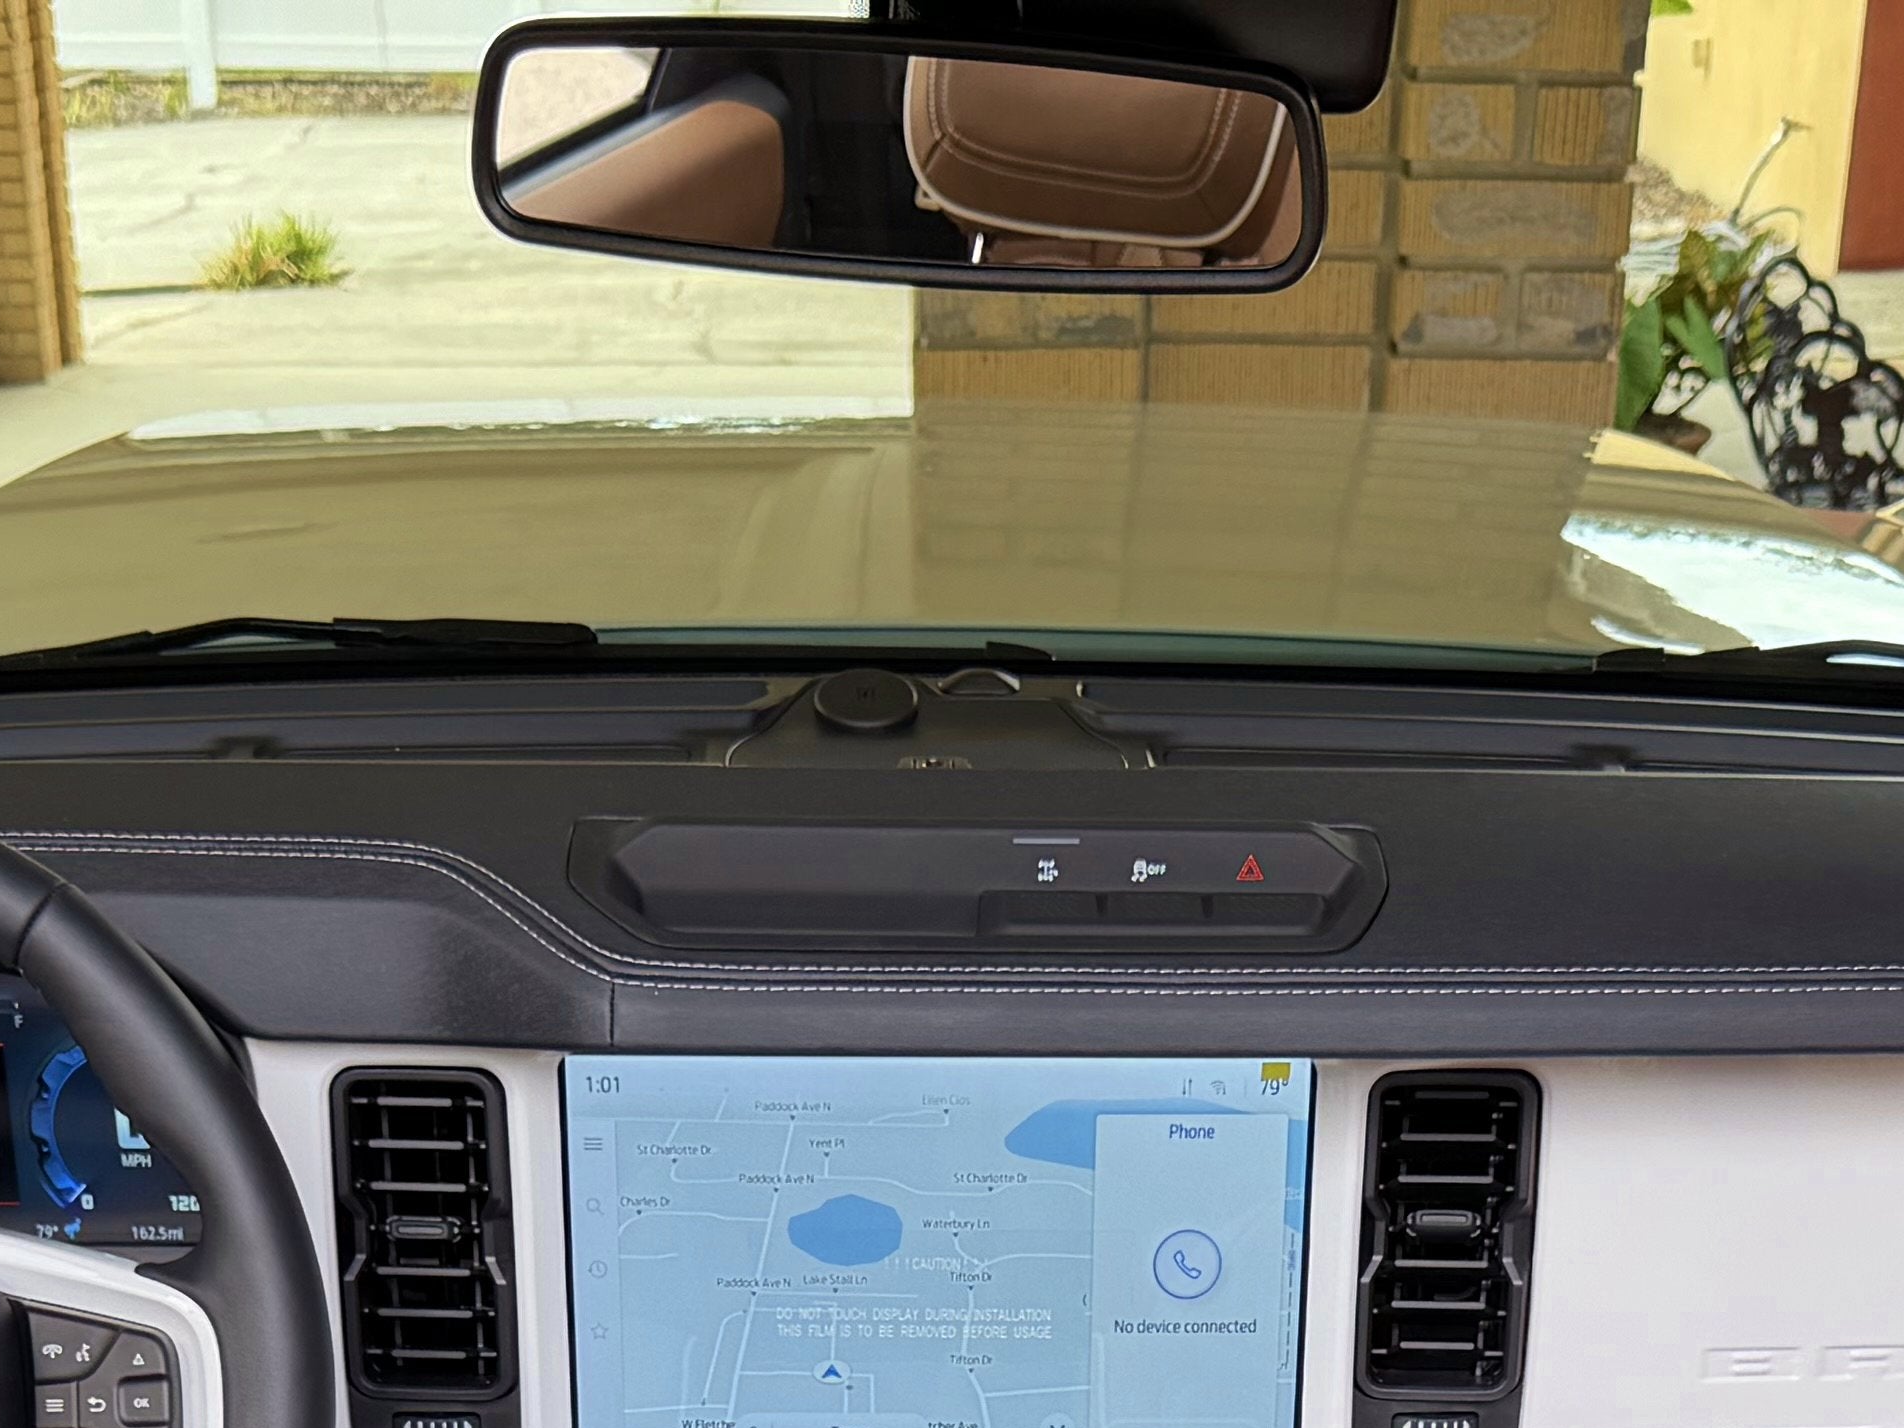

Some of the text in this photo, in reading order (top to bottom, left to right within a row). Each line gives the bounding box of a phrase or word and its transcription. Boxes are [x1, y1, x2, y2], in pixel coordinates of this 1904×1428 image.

[13, 1015, 24, 1029] F
[585, 1076, 621, 1094] 1:01
[755, 1101, 832, 1112] Paddock Ave N
[1169, 1123, 1216, 1139] Phone
[650, 1144, 698, 1155] Charlotte
[700, 1145, 712, 1155] Dr
[120, 1154, 153, 1168] MPH
[739, 1174, 815, 1185] Paddock Ave N
[953, 1173, 1028, 1184] St Charlotte Dr
[81, 1194, 95, 1210] 0
[169, 1195, 201, 1212] 120
[620, 1196, 671, 1207] Charles Dr
[922, 1219, 991, 1231] Waterbury Ln
[35, 1224, 59, 1240] 79°
[912, 1258, 961, 1271] CAUTION
[717, 1277, 792, 1288] Paddock Ave N
[803, 1275, 827, 1286] Lake
[855, 1275, 868, 1285] Ln
[950, 1272, 993, 1282] Tifton Dr
[776, 1307, 1052, 1322] DO NOT TOUCH DISPLAY DURING INSTALLATION
[777, 1324, 1053, 1339] THIS FILM IS TO BE REMOVED BEFORE USAGE
[1114, 1319, 1257, 1334] No device connected
[950, 1354, 993, 1365] Tifton Dr
[133, 1398, 150, 1409] OK
